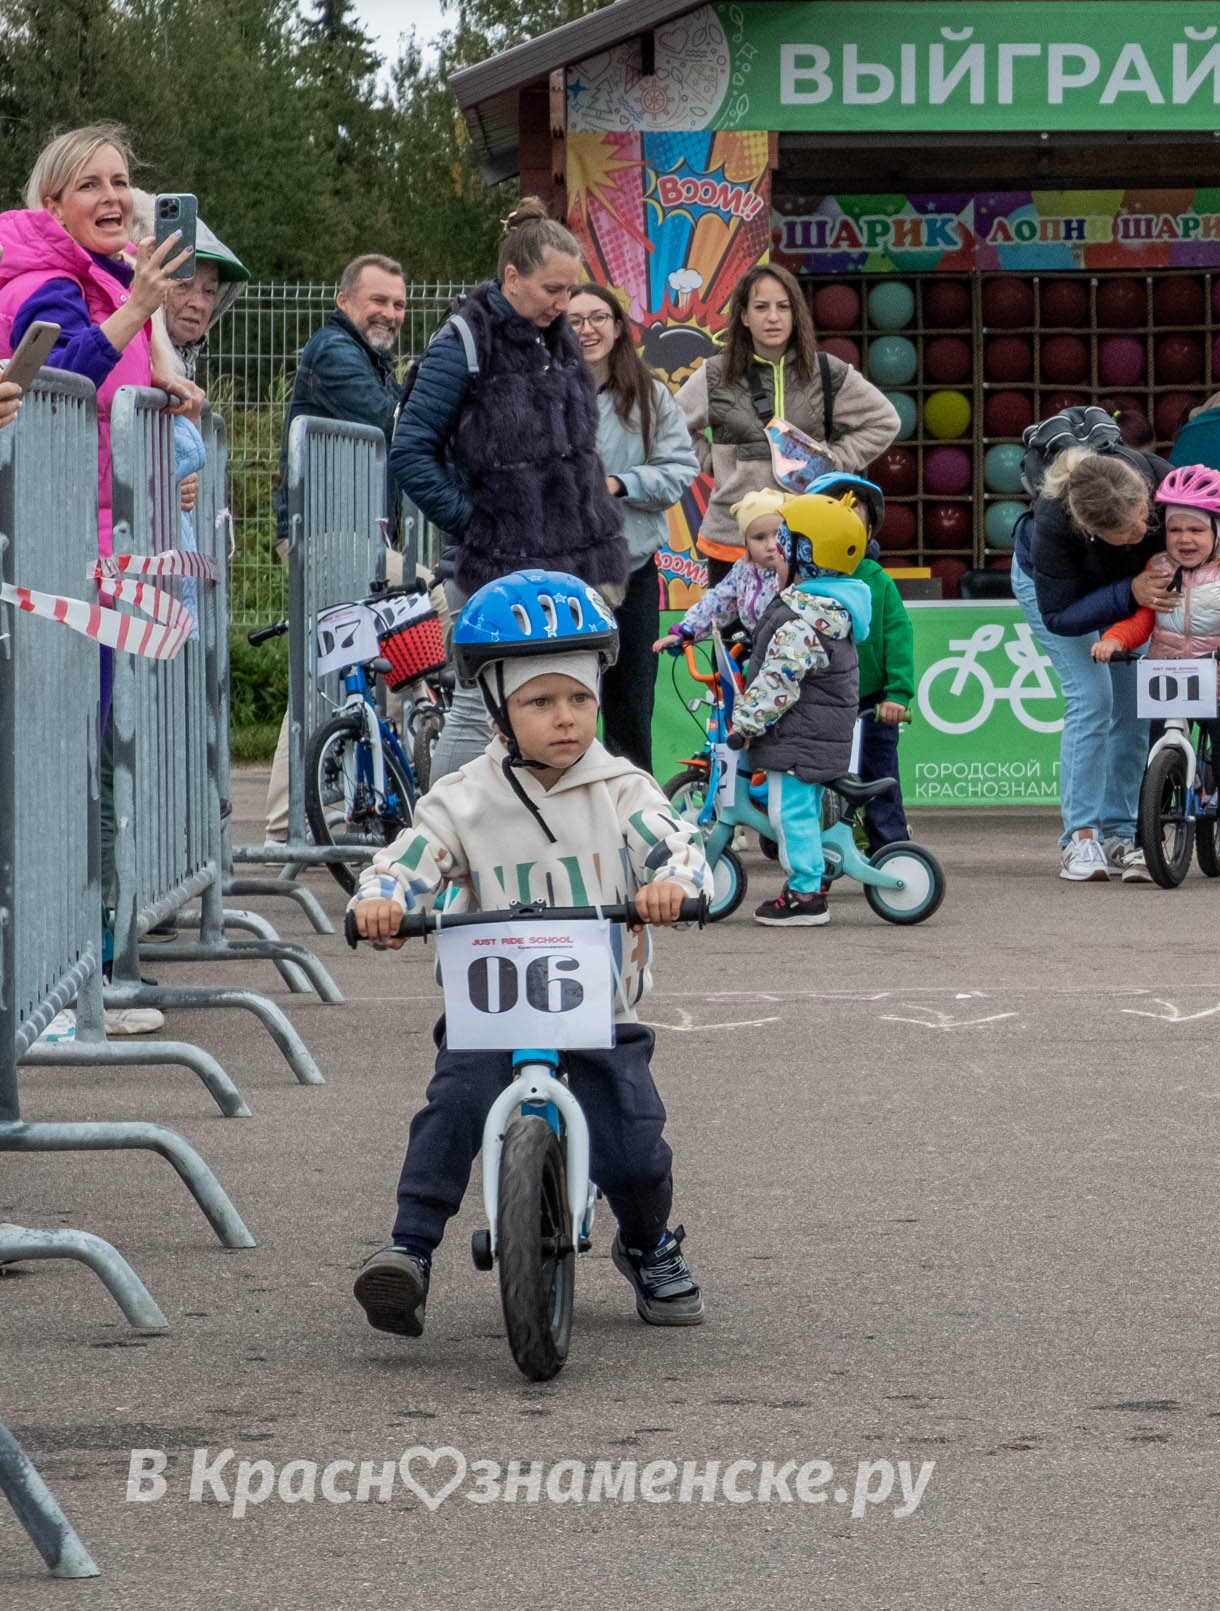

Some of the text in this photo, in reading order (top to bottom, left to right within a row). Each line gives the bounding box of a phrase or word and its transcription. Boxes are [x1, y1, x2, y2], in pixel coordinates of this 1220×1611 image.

[657, 175, 764, 221] BOOM!!
[782, 215, 960, 249] ШАРИК
[1149, 674, 1205, 702] 01
[915, 759, 1041, 781] ГОРОДСКОЙ
[915, 781, 1057, 798] КРАСНОЗНАМ
[467, 954, 584, 1014] 06
